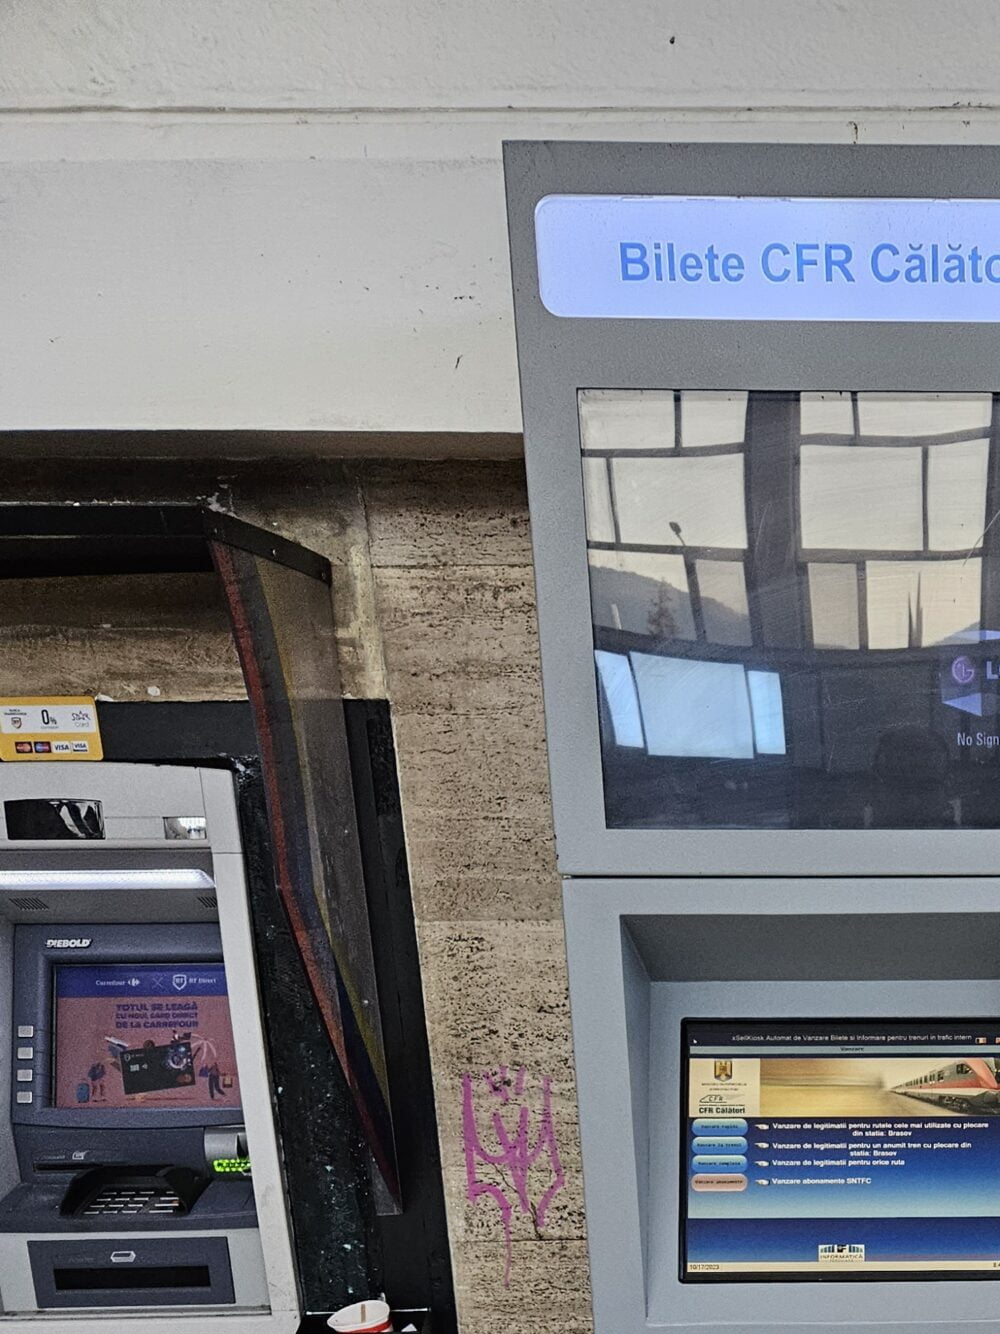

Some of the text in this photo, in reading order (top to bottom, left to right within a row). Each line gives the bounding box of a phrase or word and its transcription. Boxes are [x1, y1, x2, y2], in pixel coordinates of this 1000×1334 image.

[620, 242, 745, 282] Bilete
[761, 242, 856, 282] CFR
[957, 732, 973, 746] No
[45, 938, 92, 948] DIEBOLD
[116, 1003, 149, 1012] TOTUL
[151, 1003, 164, 1011] SE
[116, 1021, 128, 1029] DE
[143, 1020, 198, 1028] CARREFOUR
[887, 1034, 907, 1042] pentru
[848, 1122, 871, 1130] pentru
[963, 1122, 989, 1130] plecare
[848, 1142, 871, 1150] pentru
[933, 1142, 959, 1150] plecare
[848, 1159, 871, 1167] pentru
